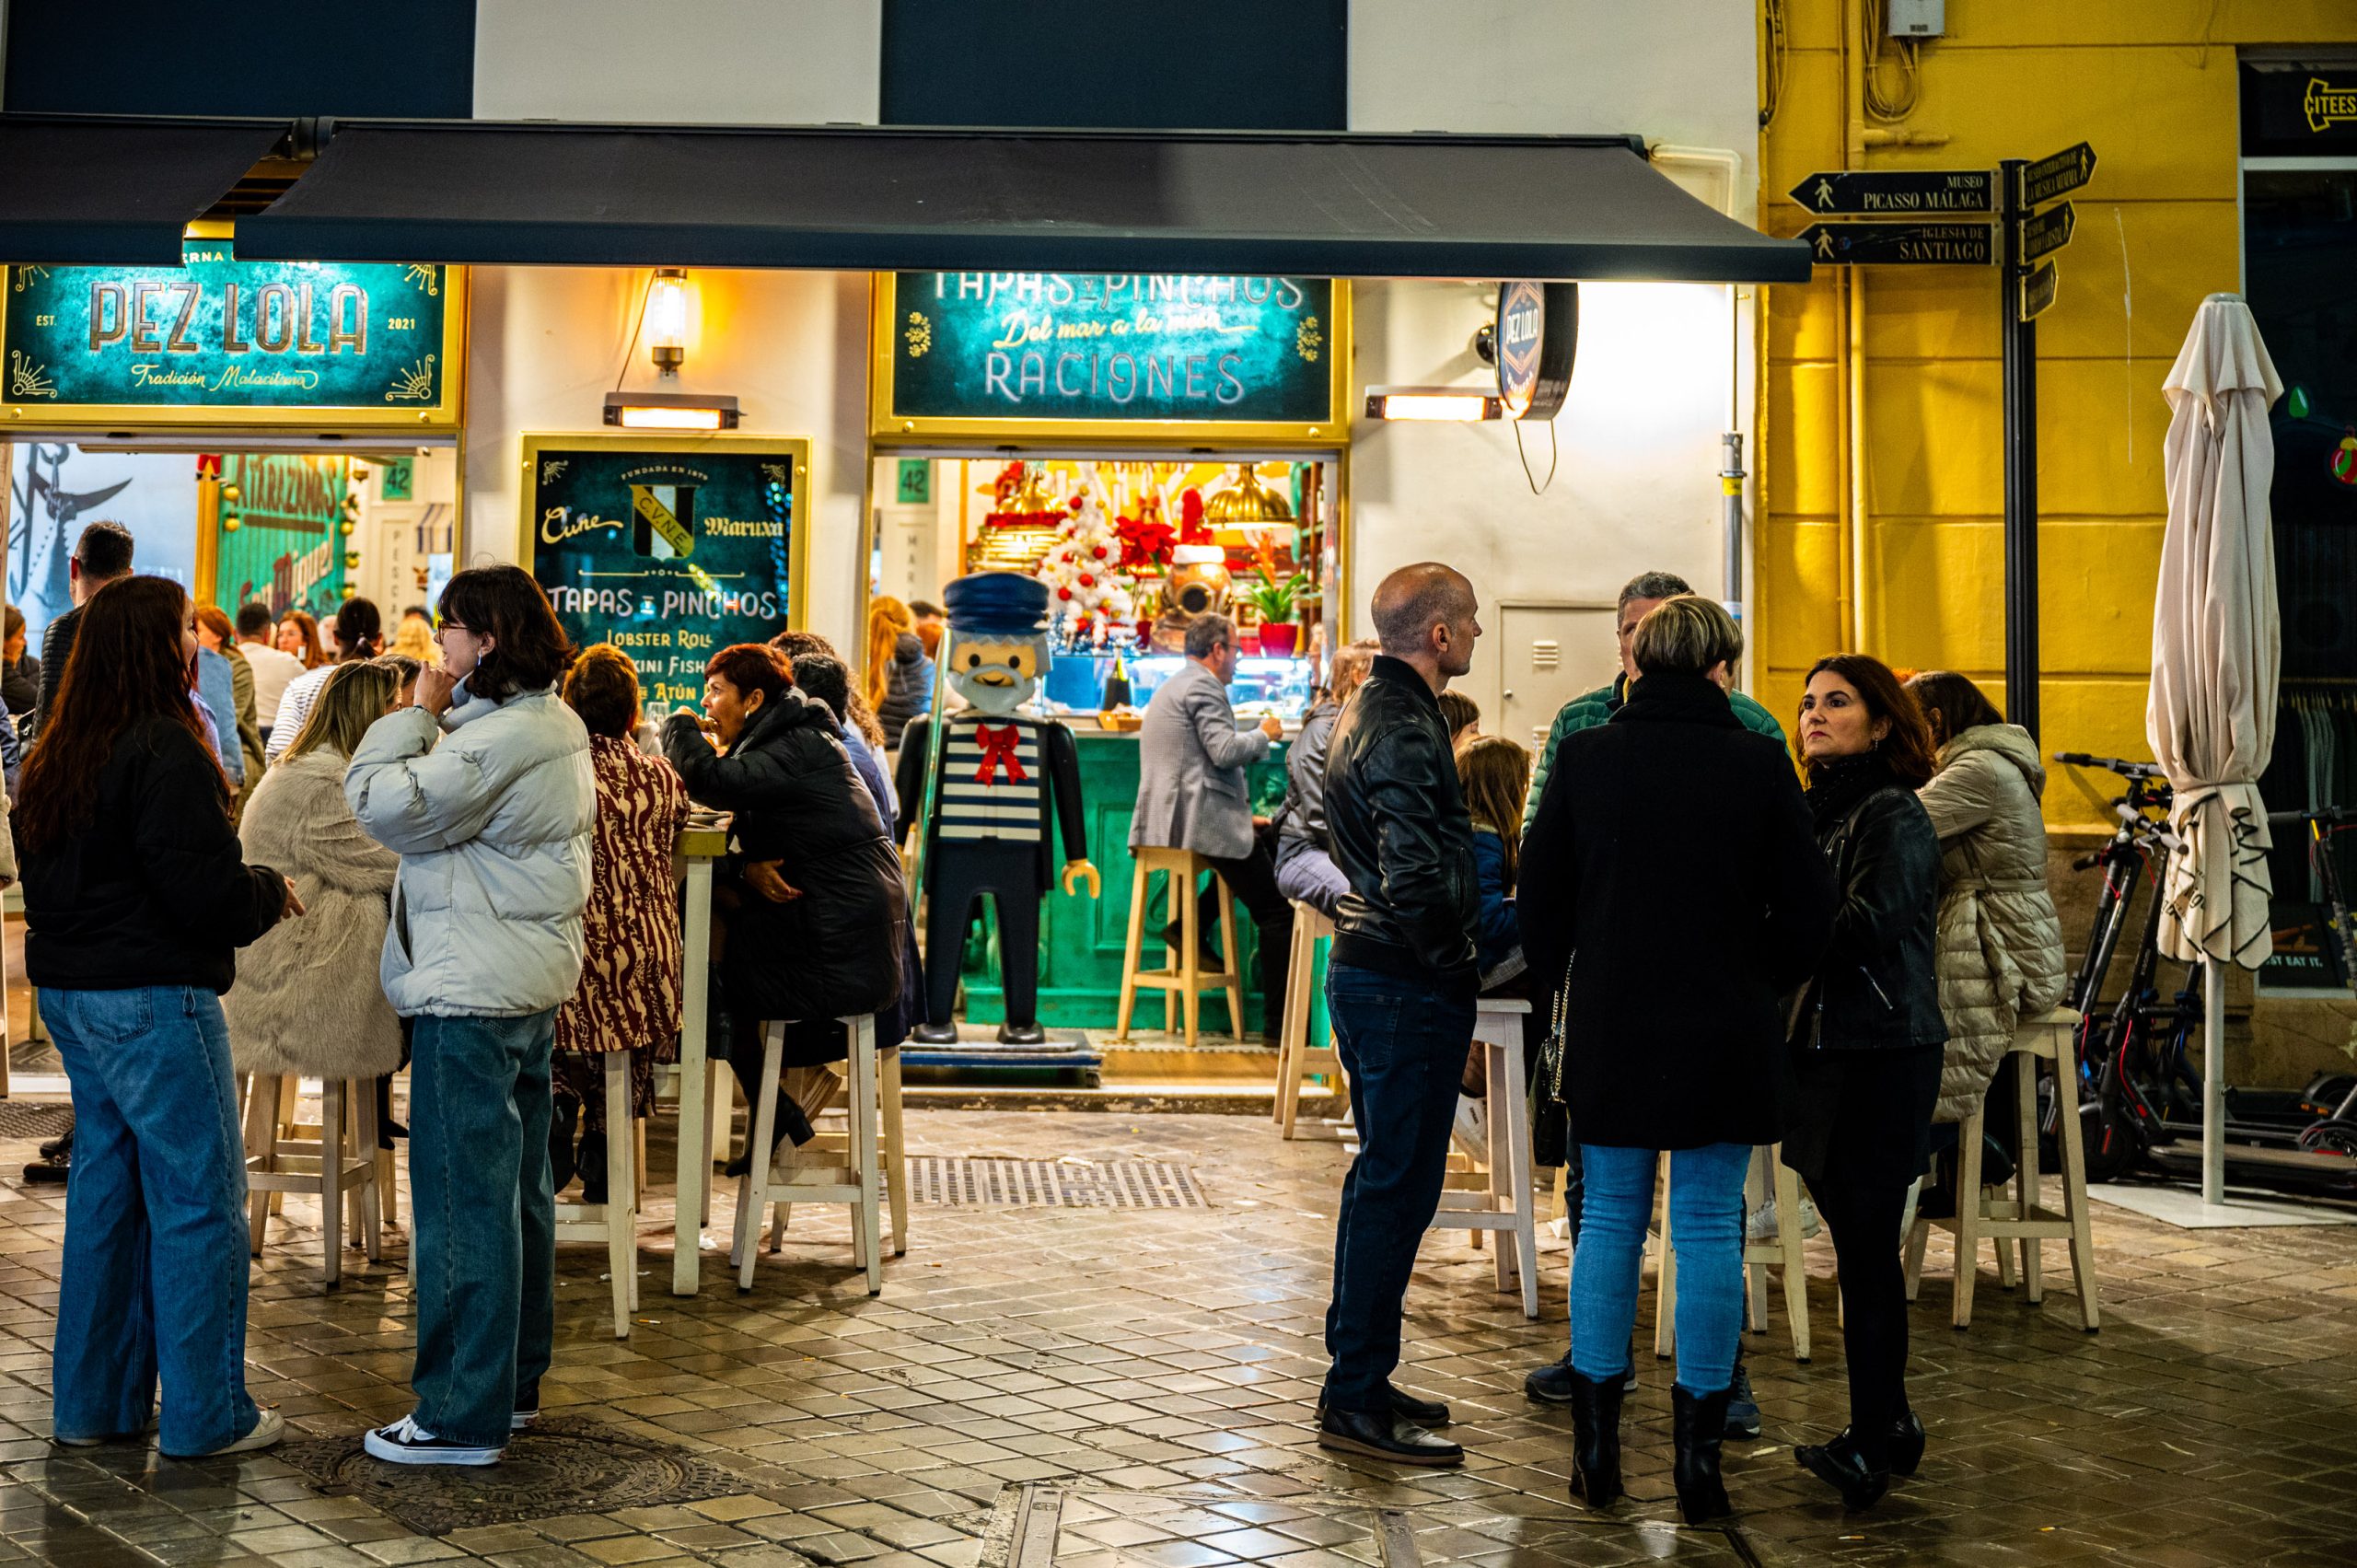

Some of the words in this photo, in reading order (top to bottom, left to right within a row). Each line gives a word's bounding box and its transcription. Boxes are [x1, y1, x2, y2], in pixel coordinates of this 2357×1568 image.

[1947, 175, 1983, 188] MUSEO
[1864, 192, 1920, 209] PICASSO
[1925, 188, 1984, 208] MÁLAGA
[1922, 227, 1966, 239] IGLESIA
[1970, 227, 1984, 239] DE
[1899, 241, 1984, 261] SANTIAGO
[36, 315, 57, 327] EST.
[89, 282, 202, 354] PEZ
[223, 282, 367, 355] LOLA
[388, 318, 415, 331] 2021
[993, 308, 1052, 348] Del
[1057, 319, 1105, 339] mar
[1110, 319, 1130, 334] a
[1135, 308, 1163, 333] la
[1506, 313, 1521, 344] PEZ
[1521, 308, 1538, 341] LOLA
[131, 365, 206, 388] Tradición
[209, 365, 319, 391] Malacitana
[985, 352, 1244, 403] RACIONES
[387, 467, 410, 491] 42
[621, 465, 668, 480] FUNDADA
[901, 469, 925, 493] 42
[541, 506, 623, 544] Cune
[704, 517, 784, 537] Maruxa
[546, 586, 633, 616] TAPAS
[662, 591, 777, 620] PINCHOS
[608, 629, 670, 646] LOBSTER
[678, 629, 714, 649] ROLL
[668, 656, 705, 677] FISH
[654, 682, 697, 704] ATÚN
[2285, 956, 2306, 967] EAT
